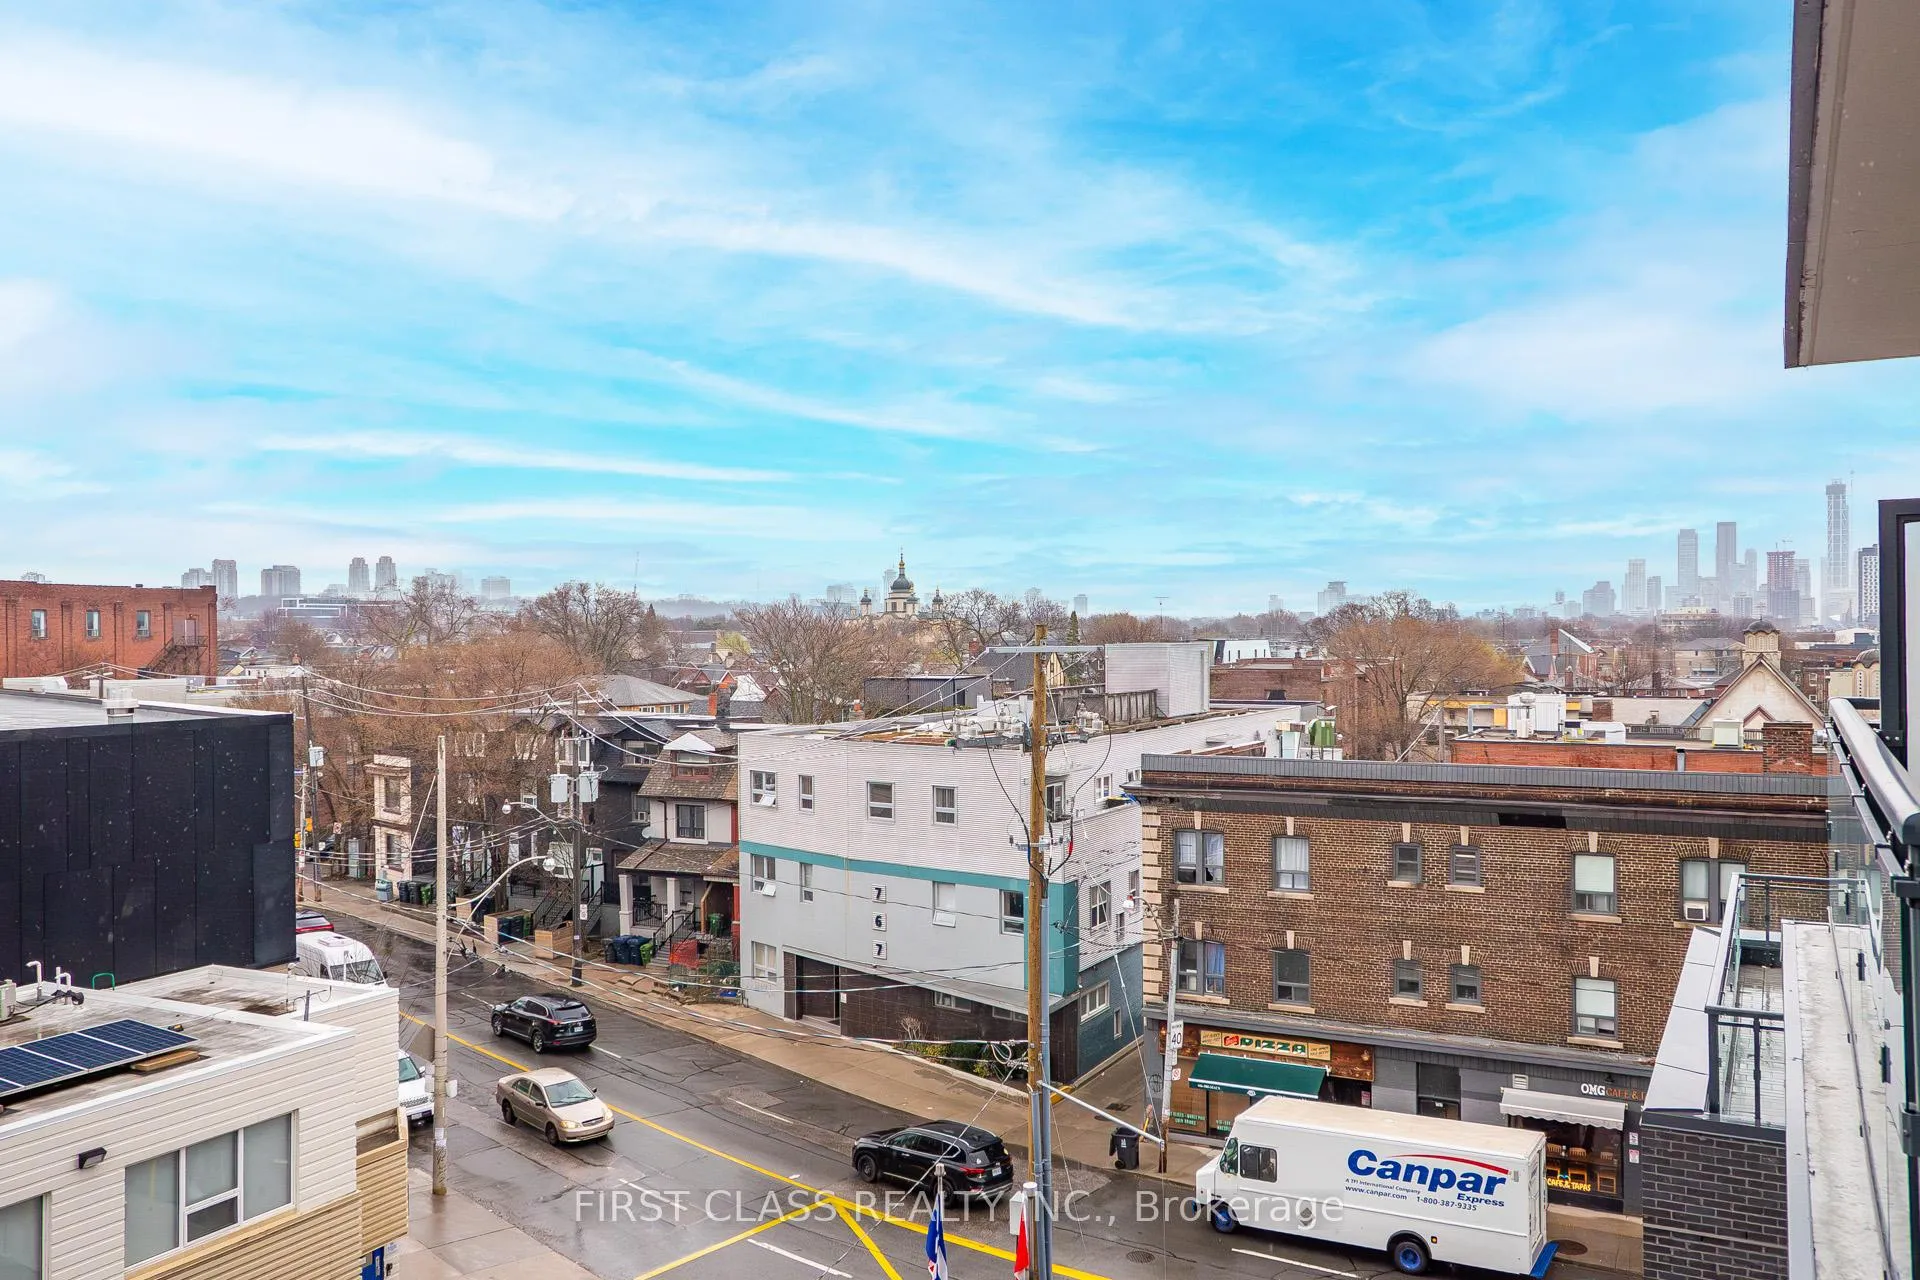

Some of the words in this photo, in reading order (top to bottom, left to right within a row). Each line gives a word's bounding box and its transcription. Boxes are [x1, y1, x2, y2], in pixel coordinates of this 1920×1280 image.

[1171, 1032, 1182, 1045] 40
[1240, 1037, 1306, 1055] PIZZA
[1580, 1083, 1606, 1096] OMG
[1347, 1149, 1507, 1196] Canpar
[1360, 1181, 1395, 1190] International
[1395, 1185, 1421, 1195] Company
[1571, 1182, 1592, 1192] TAPAS
[1345, 1186, 1408, 1200] www.canpar.com
[1416, 1196, 1478, 1212] 1-800-387-9335
[1457, 1192, 1505, 1207] Express
